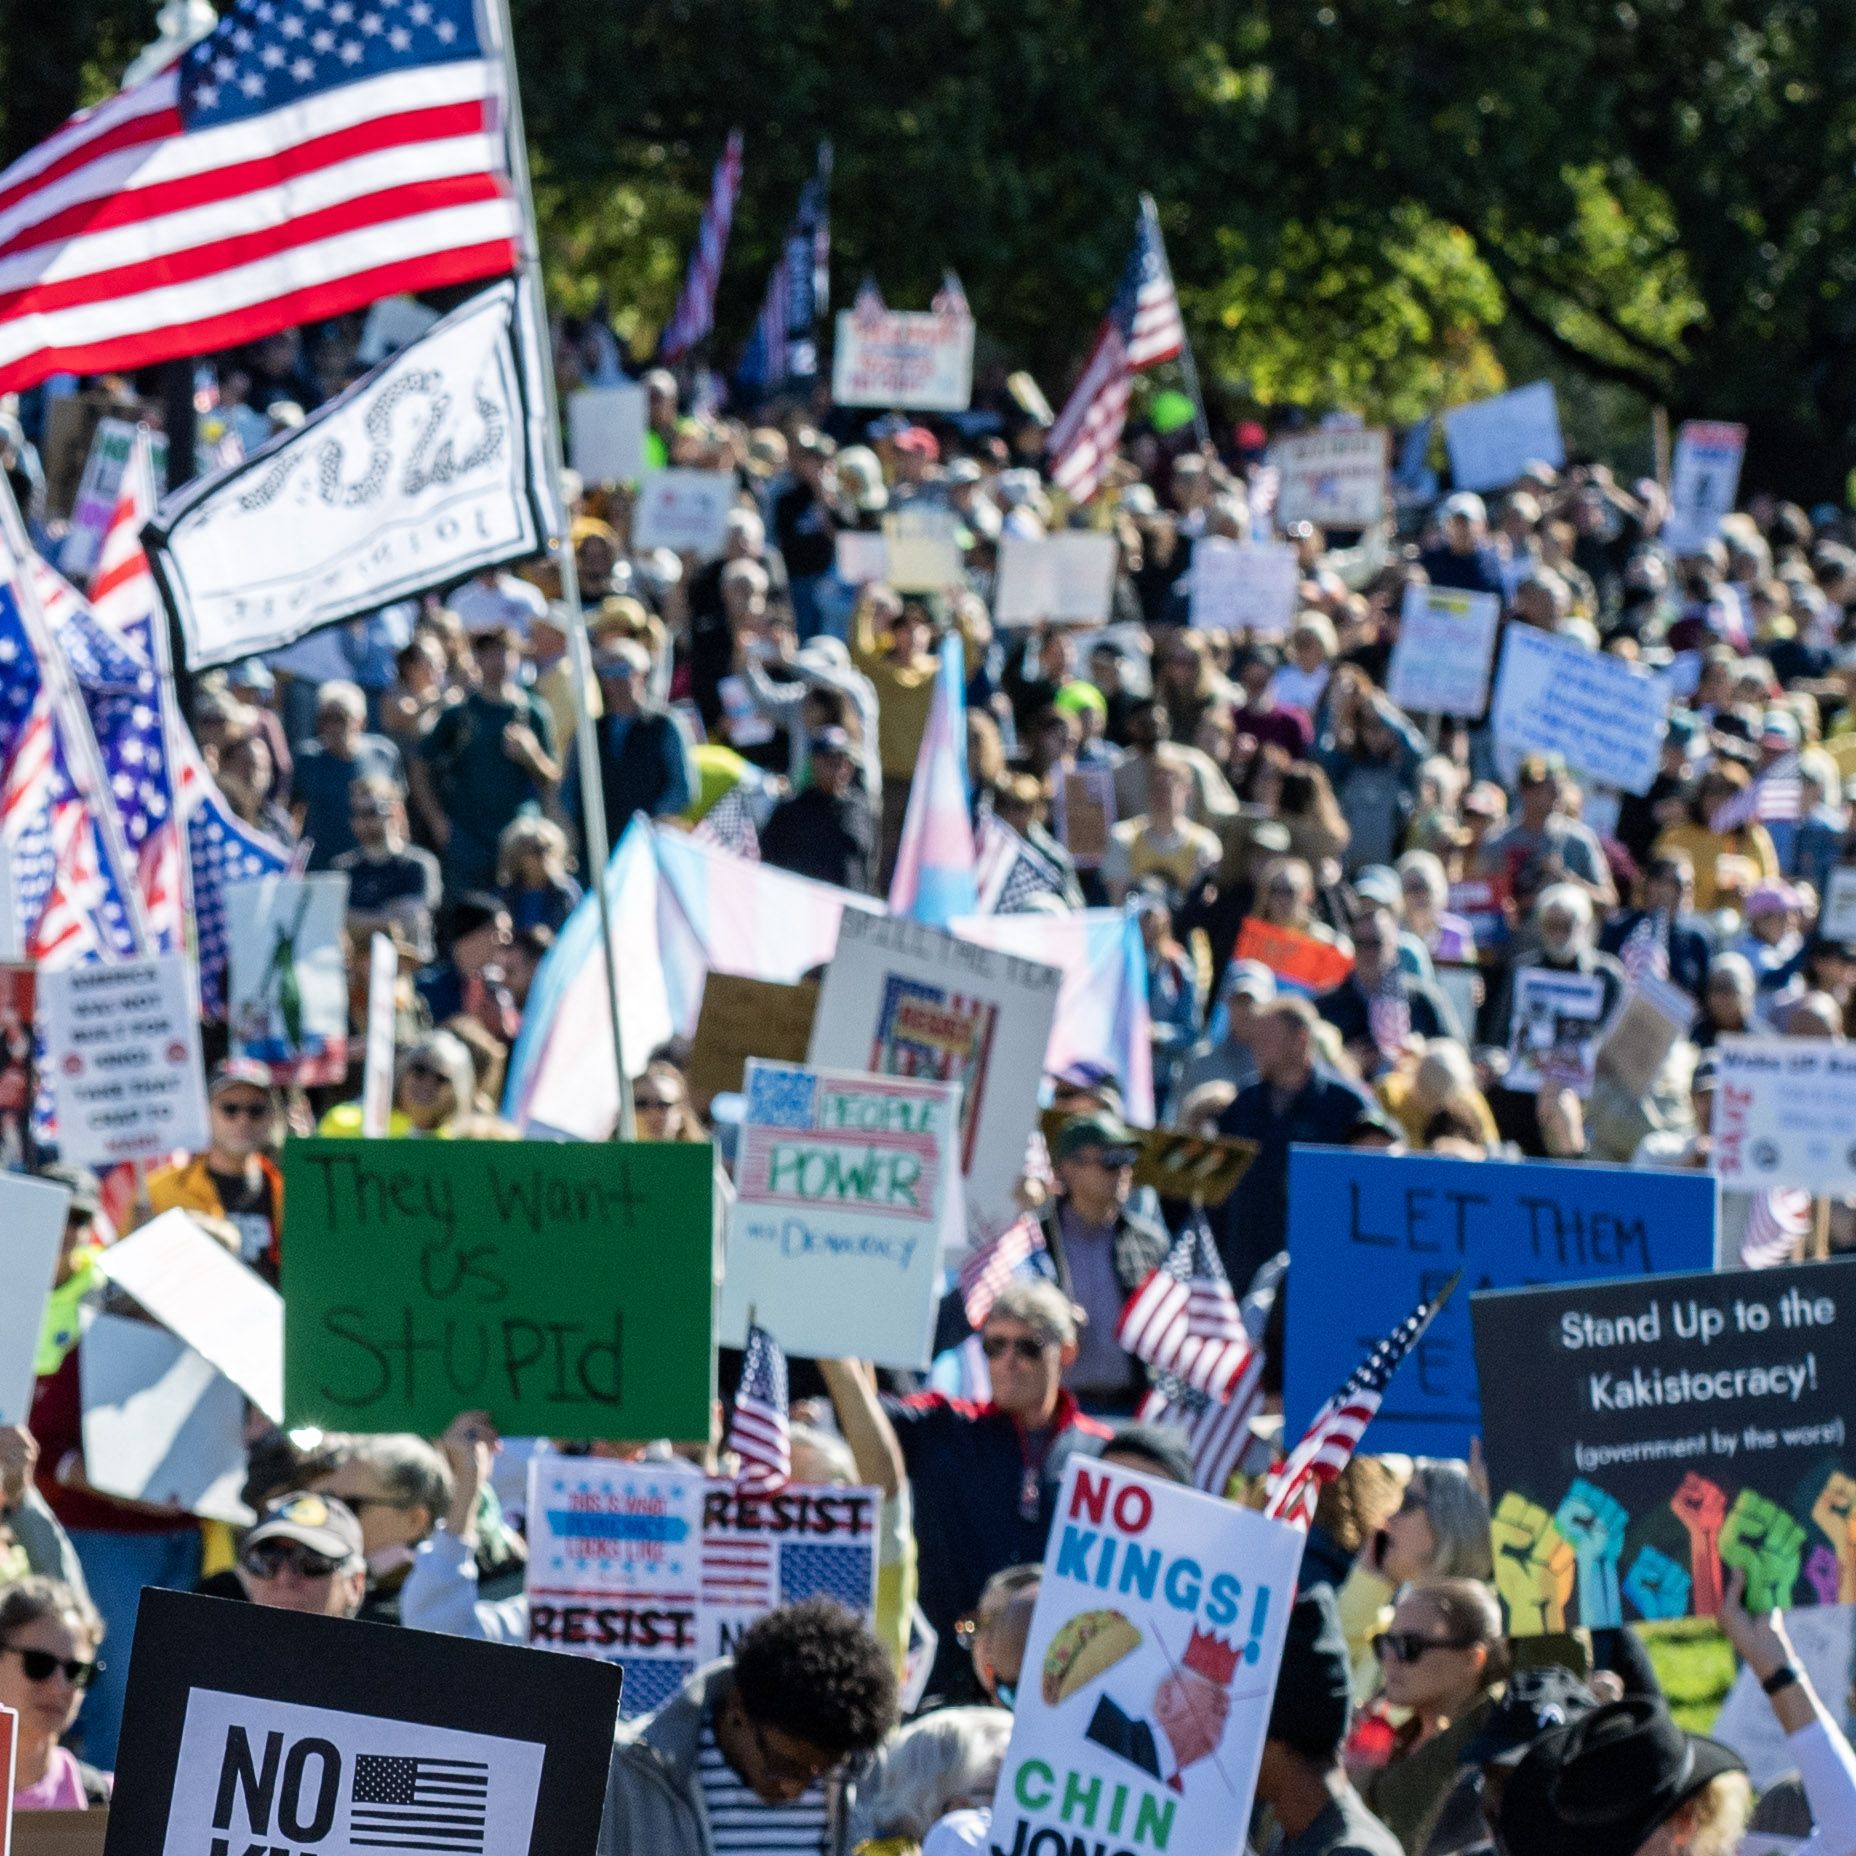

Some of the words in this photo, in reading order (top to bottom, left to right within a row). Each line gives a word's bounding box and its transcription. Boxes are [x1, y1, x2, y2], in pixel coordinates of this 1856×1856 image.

[820, 1093, 938, 1132] PEOPLE
[303, 1152, 457, 1250] They
[768, 1144, 921, 1208] POWER
[1349, 1182, 1489, 1255] LET
[1518, 1196, 1652, 1273] THEM
[1561, 1302, 1661, 1350] Stand
[1673, 1305, 1724, 1348] Up
[1735, 1303, 1770, 1335] to
[1780, 1294, 1836, 1329] the
[1590, 1353, 1819, 1412] Kakistocracy!
[1573, 1434, 1706, 1472] (government
[1712, 1431, 1738, 1459] by
[1742, 1426, 1776, 1449] the
[1781, 1417, 1845, 1448] worst)
[703, 1490, 872, 1536] RESIST
[1069, 1467, 1154, 1536] NO
[530, 1606, 695, 1648] RESIST
[1055, 1526, 1274, 1666] KINGS!
[212, 1724, 342, 1844] NO
[1013, 1759, 1177, 1852] CHIN
